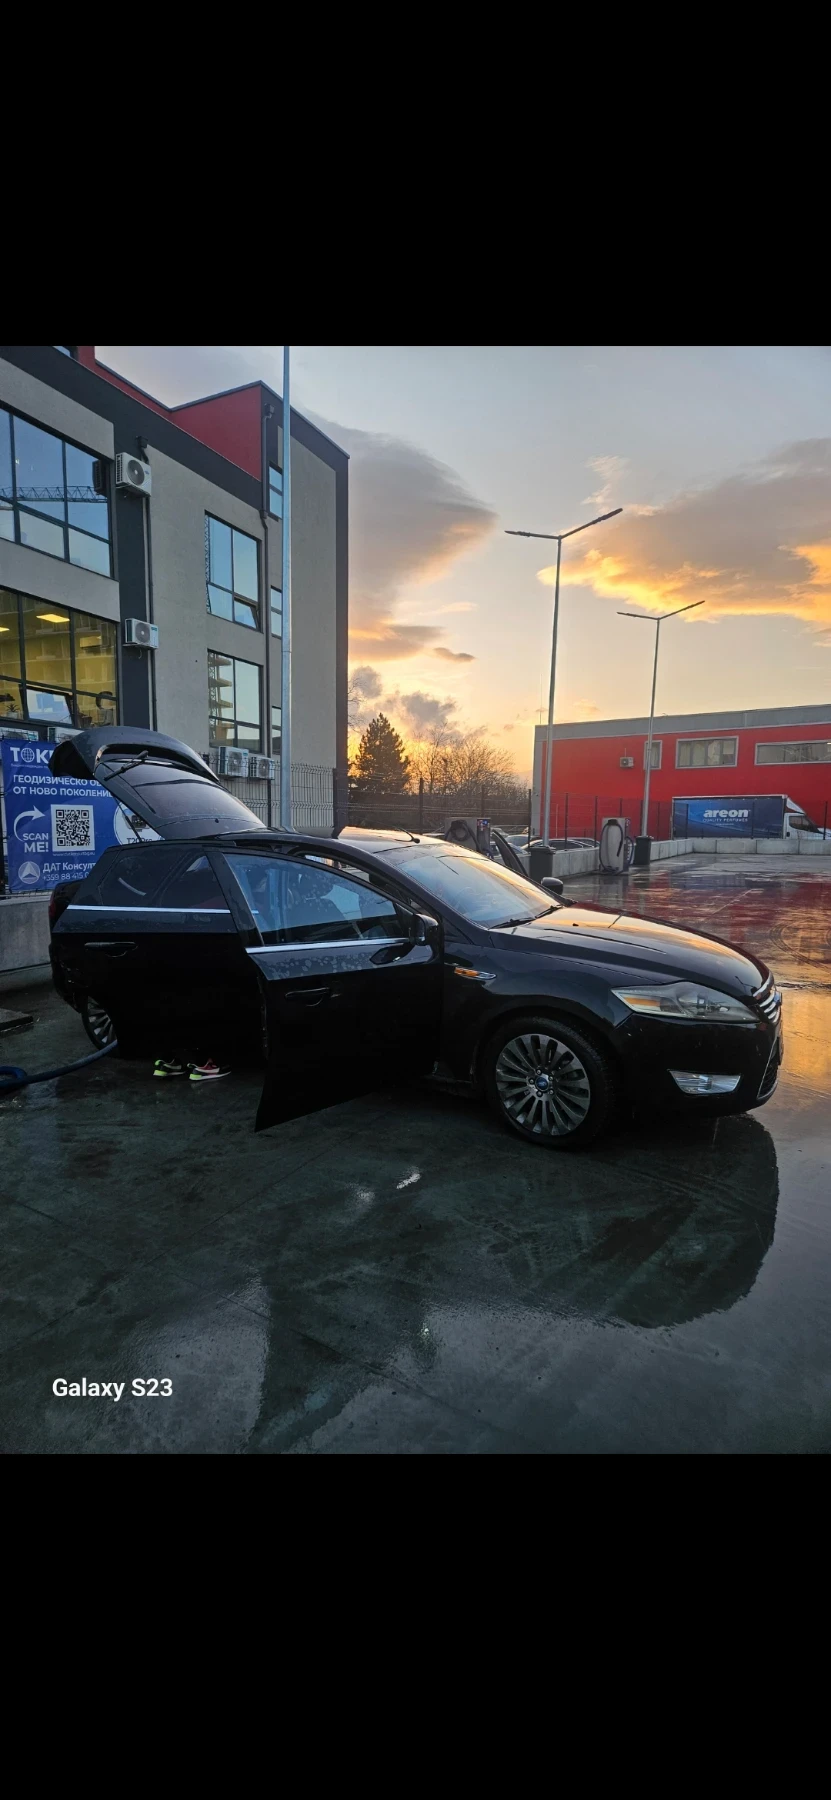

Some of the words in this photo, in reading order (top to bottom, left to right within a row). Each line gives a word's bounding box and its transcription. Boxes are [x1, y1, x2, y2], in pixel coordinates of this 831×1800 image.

[10, 747, 54, 764] TOK
[13, 774, 88, 786] ГЕОДИЗИЧЕСКО
[13, 786, 27, 795] ОТ
[29, 787, 58, 796] НОВО
[703, 809, 749, 818] areon
[22, 832, 49, 841] SCAN
[24, 841, 49, 853] ME!
[42, 862, 61, 873] ДАТ
